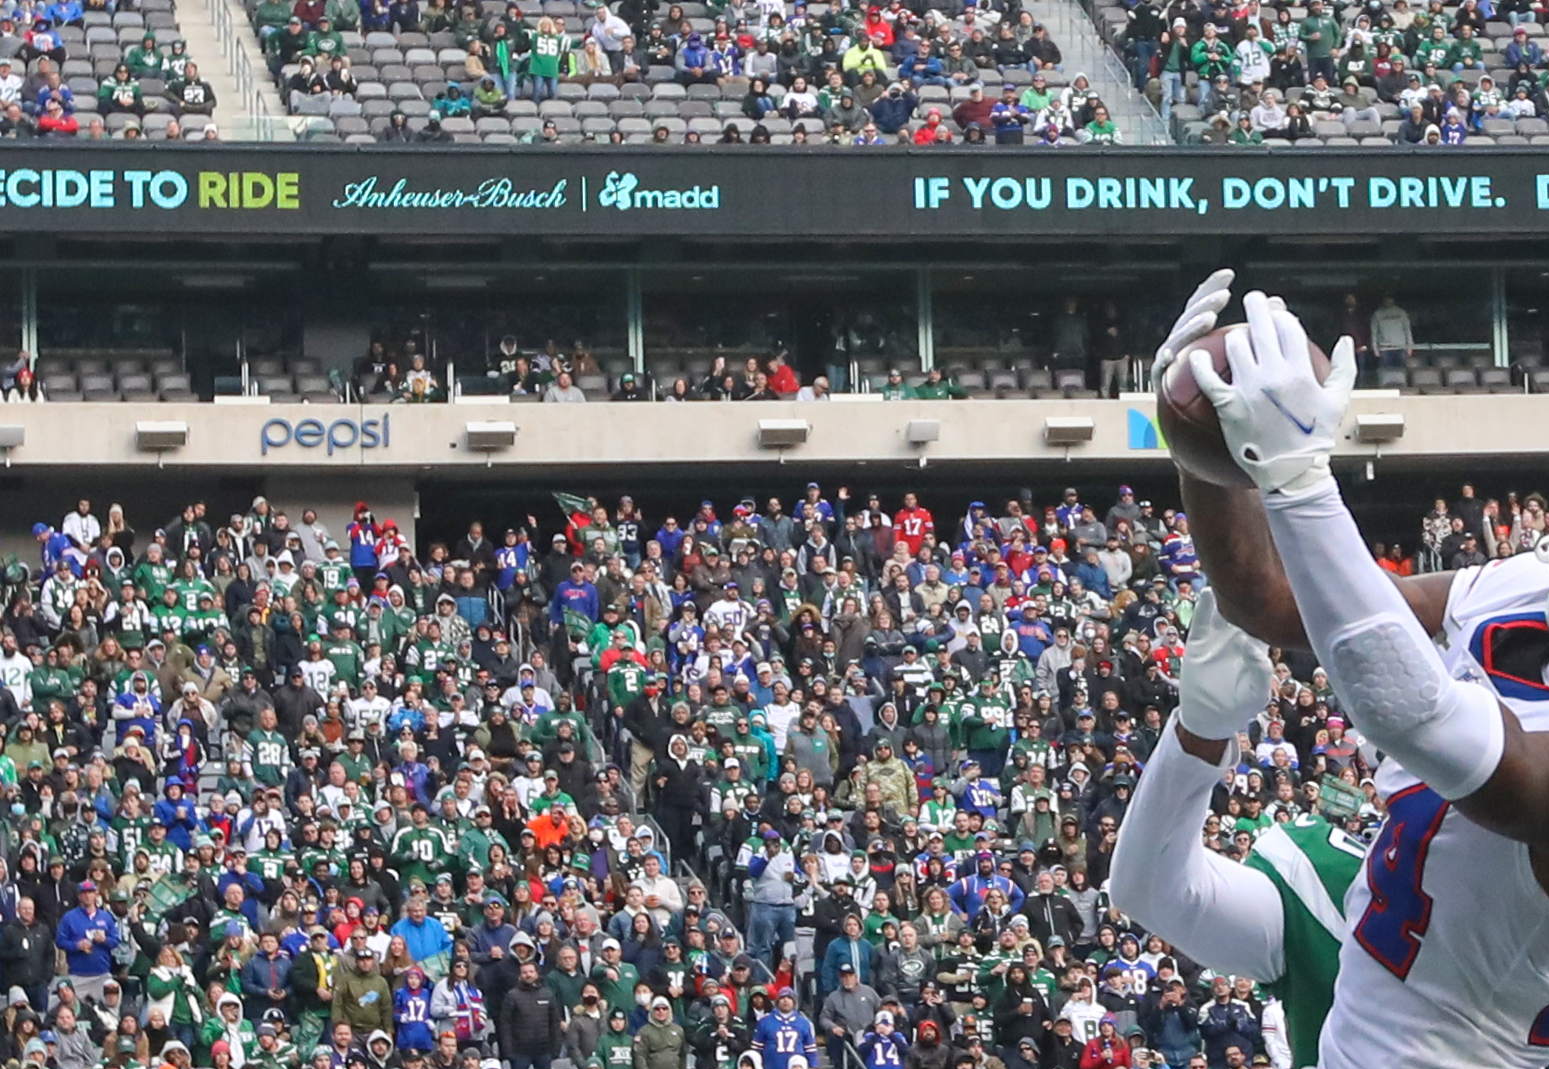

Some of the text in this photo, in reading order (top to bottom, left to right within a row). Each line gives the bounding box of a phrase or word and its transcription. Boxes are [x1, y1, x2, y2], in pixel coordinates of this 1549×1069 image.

[536, 38, 556, 56] 56
[1243, 53, 1262, 66] 12
[0, 169, 299, 209] CIDE TO RIDE
[333, 177, 566, 208] Anheuser-Busch
[634, 185, 719, 209] madd
[915, 177, 1505, 214] IF YOU DRINK, DON'T DRIVE.
[262, 412, 389, 456] pepsi
[904, 519, 922, 535] 17
[359, 530, 372, 546] 14
[324, 571, 338, 588] 19
[723, 611, 742, 625] 50
[625, 673, 637, 691] 2
[258, 744, 280, 764] 28
[971, 787, 988, 804] 17
[935, 810, 954, 826] 12
[407, 1002, 425, 1022] 17
[776, 1032, 798, 1053] 17
[875, 1043, 899, 1065] 14
